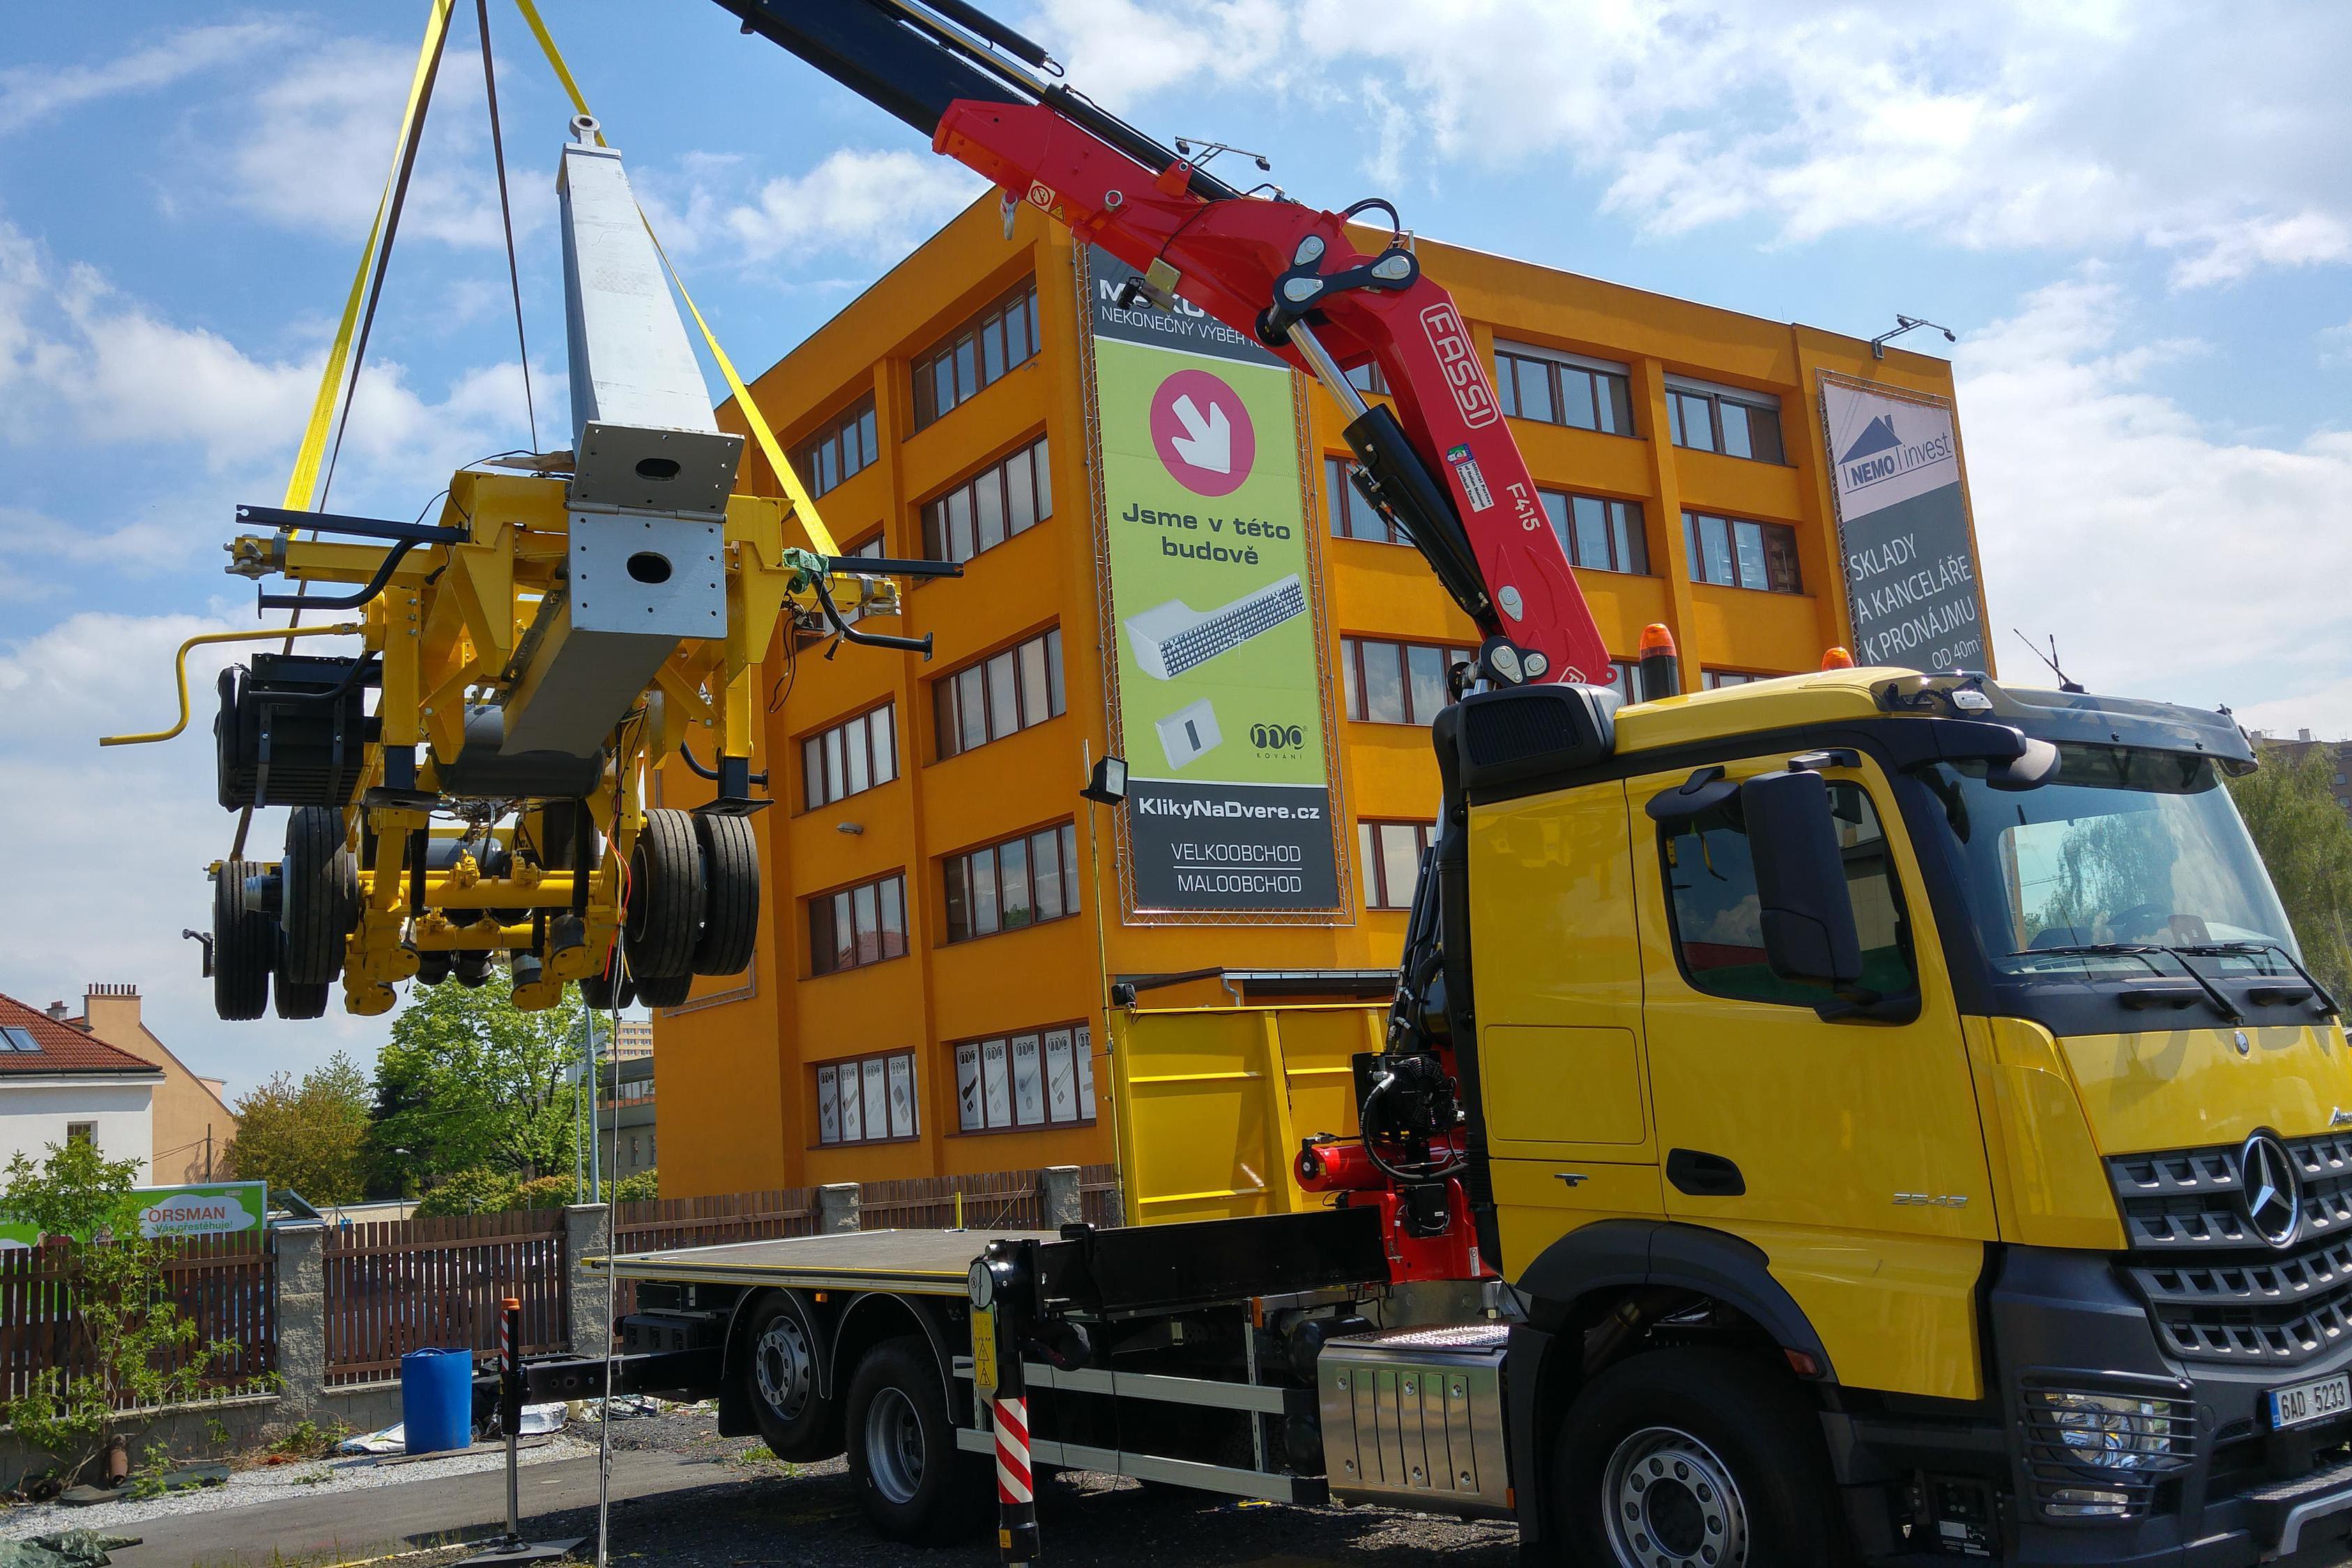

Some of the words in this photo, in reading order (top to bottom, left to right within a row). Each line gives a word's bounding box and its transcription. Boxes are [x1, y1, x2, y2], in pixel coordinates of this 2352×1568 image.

[1101, 306, 1194, 336] NEKONEČNÝ
[1198, 322, 1245, 346] VÝBĚR
[1426, 309, 1492, 420] FASSI
[1851, 455, 1895, 486] NEMO
[1903, 432, 1951, 468] invest
[1122, 502, 1198, 530] Jsme
[1209, 517, 1223, 532] v
[1233, 517, 1291, 539] této
[1506, 482, 1541, 532] F415
[1162, 537, 1259, 565] budově
[1850, 533, 1916, 581] SKLADY
[1858, 597, 1872, 624] A
[1871, 555, 1972, 617] KANCELÁŘE
[1864, 637, 1881, 666] K
[1879, 596, 1976, 659] PRONÁJMU
[1932, 647, 1951, 670] OD
[1138, 797, 1320, 820] KlikyNaDvere.cz
[1171, 843, 1301, 863] VELKOOBCHOD
[1177, 875, 1302, 893] MALOOBCHOD
[148, 1206, 225, 1223] ORSMAN
[2280, 1391, 2306, 1420] 6AD
[2314, 1381, 2346, 1412] 5233
